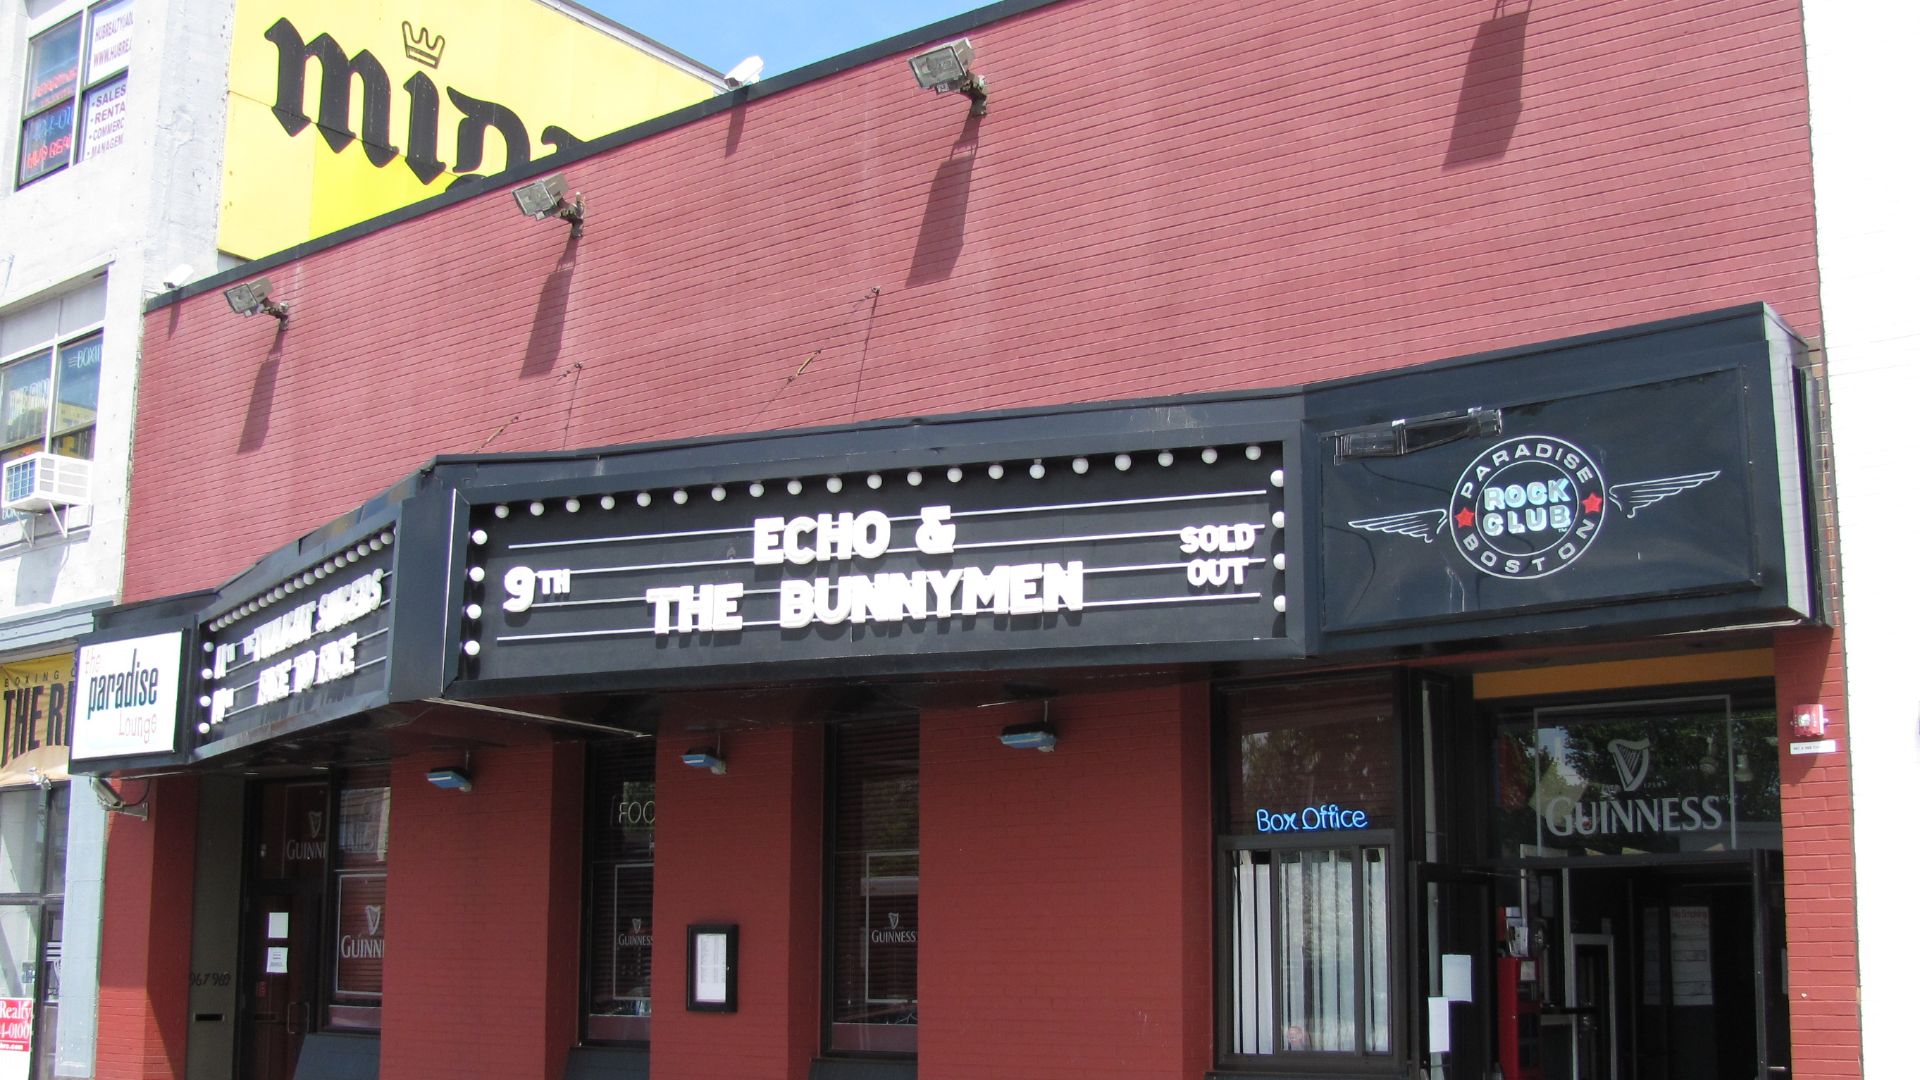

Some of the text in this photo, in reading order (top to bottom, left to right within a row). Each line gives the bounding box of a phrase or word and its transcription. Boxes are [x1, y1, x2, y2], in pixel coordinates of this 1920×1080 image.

[96, 85, 127, 107] SALES
[1461, 444, 1593, 499] PARADISE
[1484, 477, 1571, 511] ROCK
[754, 505, 956, 564] ECHO &
[1483, 504, 1571, 536] CLUB
[1180, 523, 1256, 553] SOLD
[1463, 519, 1595, 574] BOSTON
[1187, 557, 1249, 586] OUT
[646, 561, 1084, 634] THE BUNNYMEN
[5, 671, 60, 688] BOXING
[87, 648, 159, 720] paradise
[1, 686, 44, 768] THE
[118, 713, 157, 744] Lounge
[1256, 804, 1368, 832] Box Office
[1545, 796, 1723, 836] GUINNESS
[871, 930, 917, 943] GUINNESS
